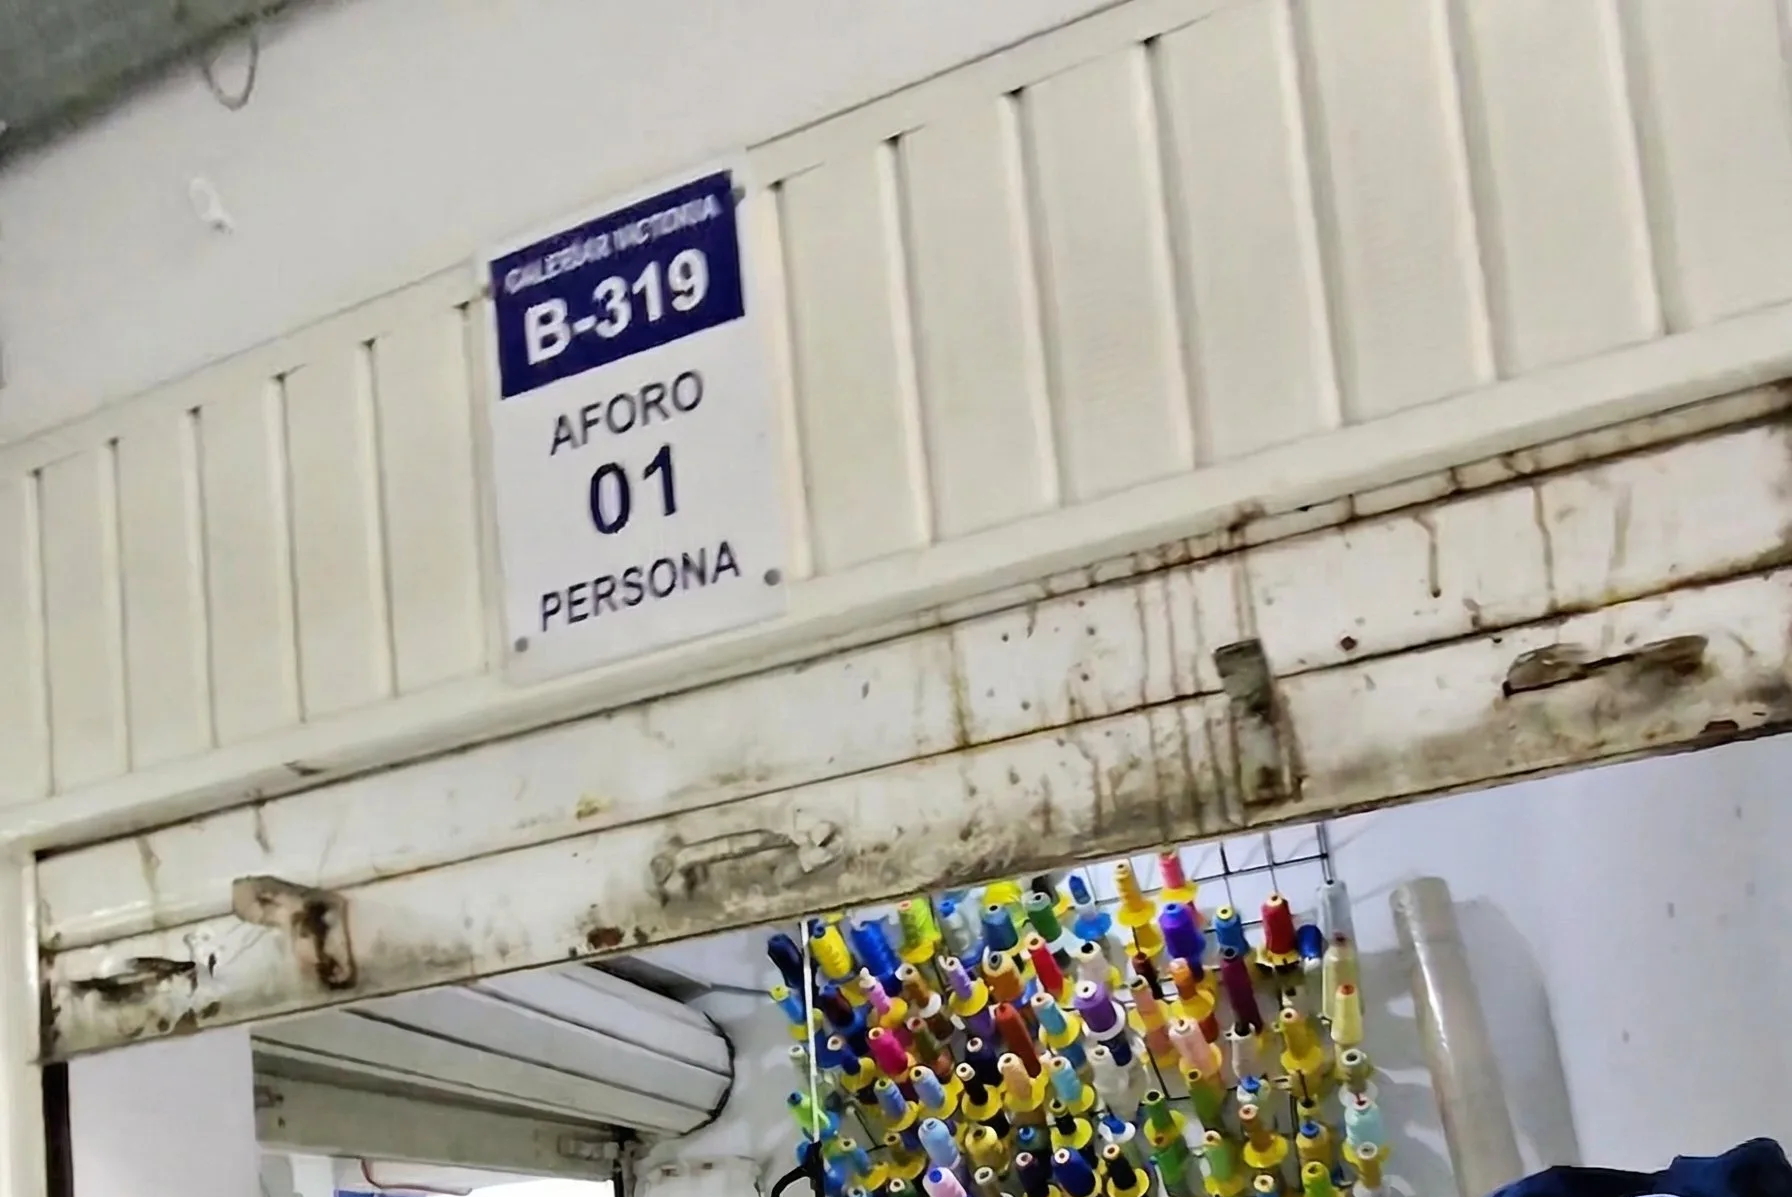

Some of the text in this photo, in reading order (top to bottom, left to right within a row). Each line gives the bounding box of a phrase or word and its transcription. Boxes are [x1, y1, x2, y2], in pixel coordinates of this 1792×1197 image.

[523, 248, 710, 366] B-319
[551, 370, 703, 455] AFORO
[590, 444, 677, 534] 01
[540, 540, 741, 632] PERSONA
